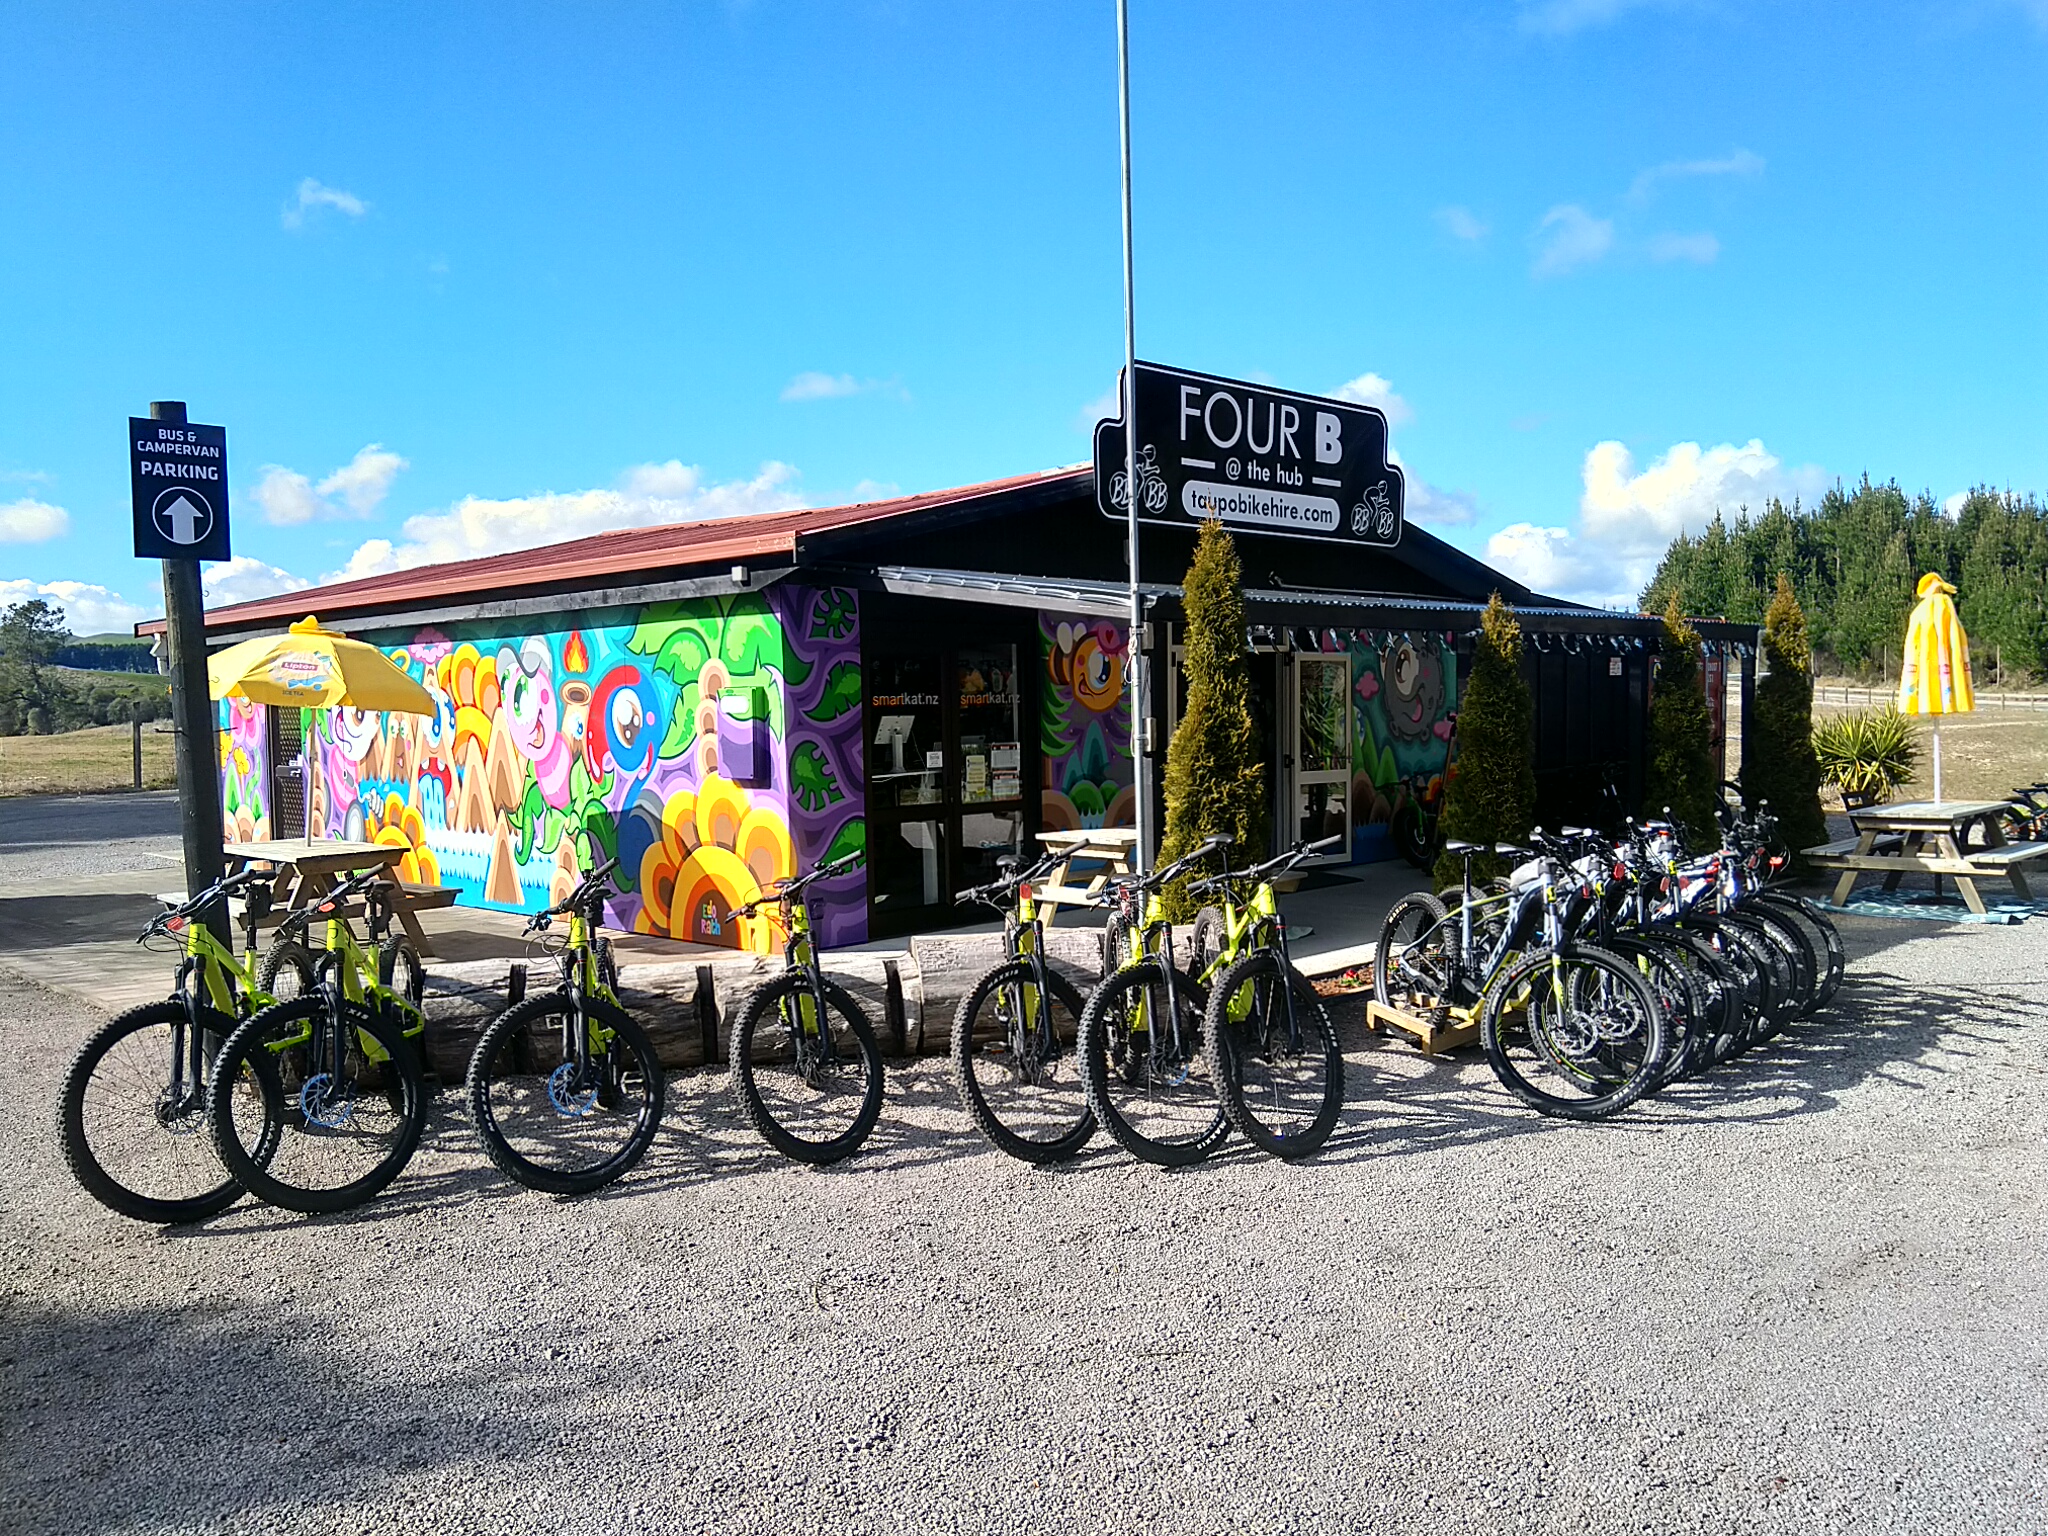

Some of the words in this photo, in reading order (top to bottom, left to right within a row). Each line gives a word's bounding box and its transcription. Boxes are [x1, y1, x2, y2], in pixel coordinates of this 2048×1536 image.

[1180, 384, 1301, 459] FOUR
[1315, 411, 1343, 465] B
[158, 429, 184, 441] BUS
[187, 432, 197, 442] &
[137, 440, 219, 458] CAMPERVAN
[141, 461, 219, 481] PARKING
[1225, 457, 1242, 480] @
[1248, 461, 1270, 482] the
[1276, 464, 1303, 487] hub
[284, 662, 316, 671] Lipton
[872, 692, 939, 706] smartkat.nz
[1317, 1003, 1338, 1048] MAXXIS
[1196, 1119, 1227, 1150] MAXXIS
